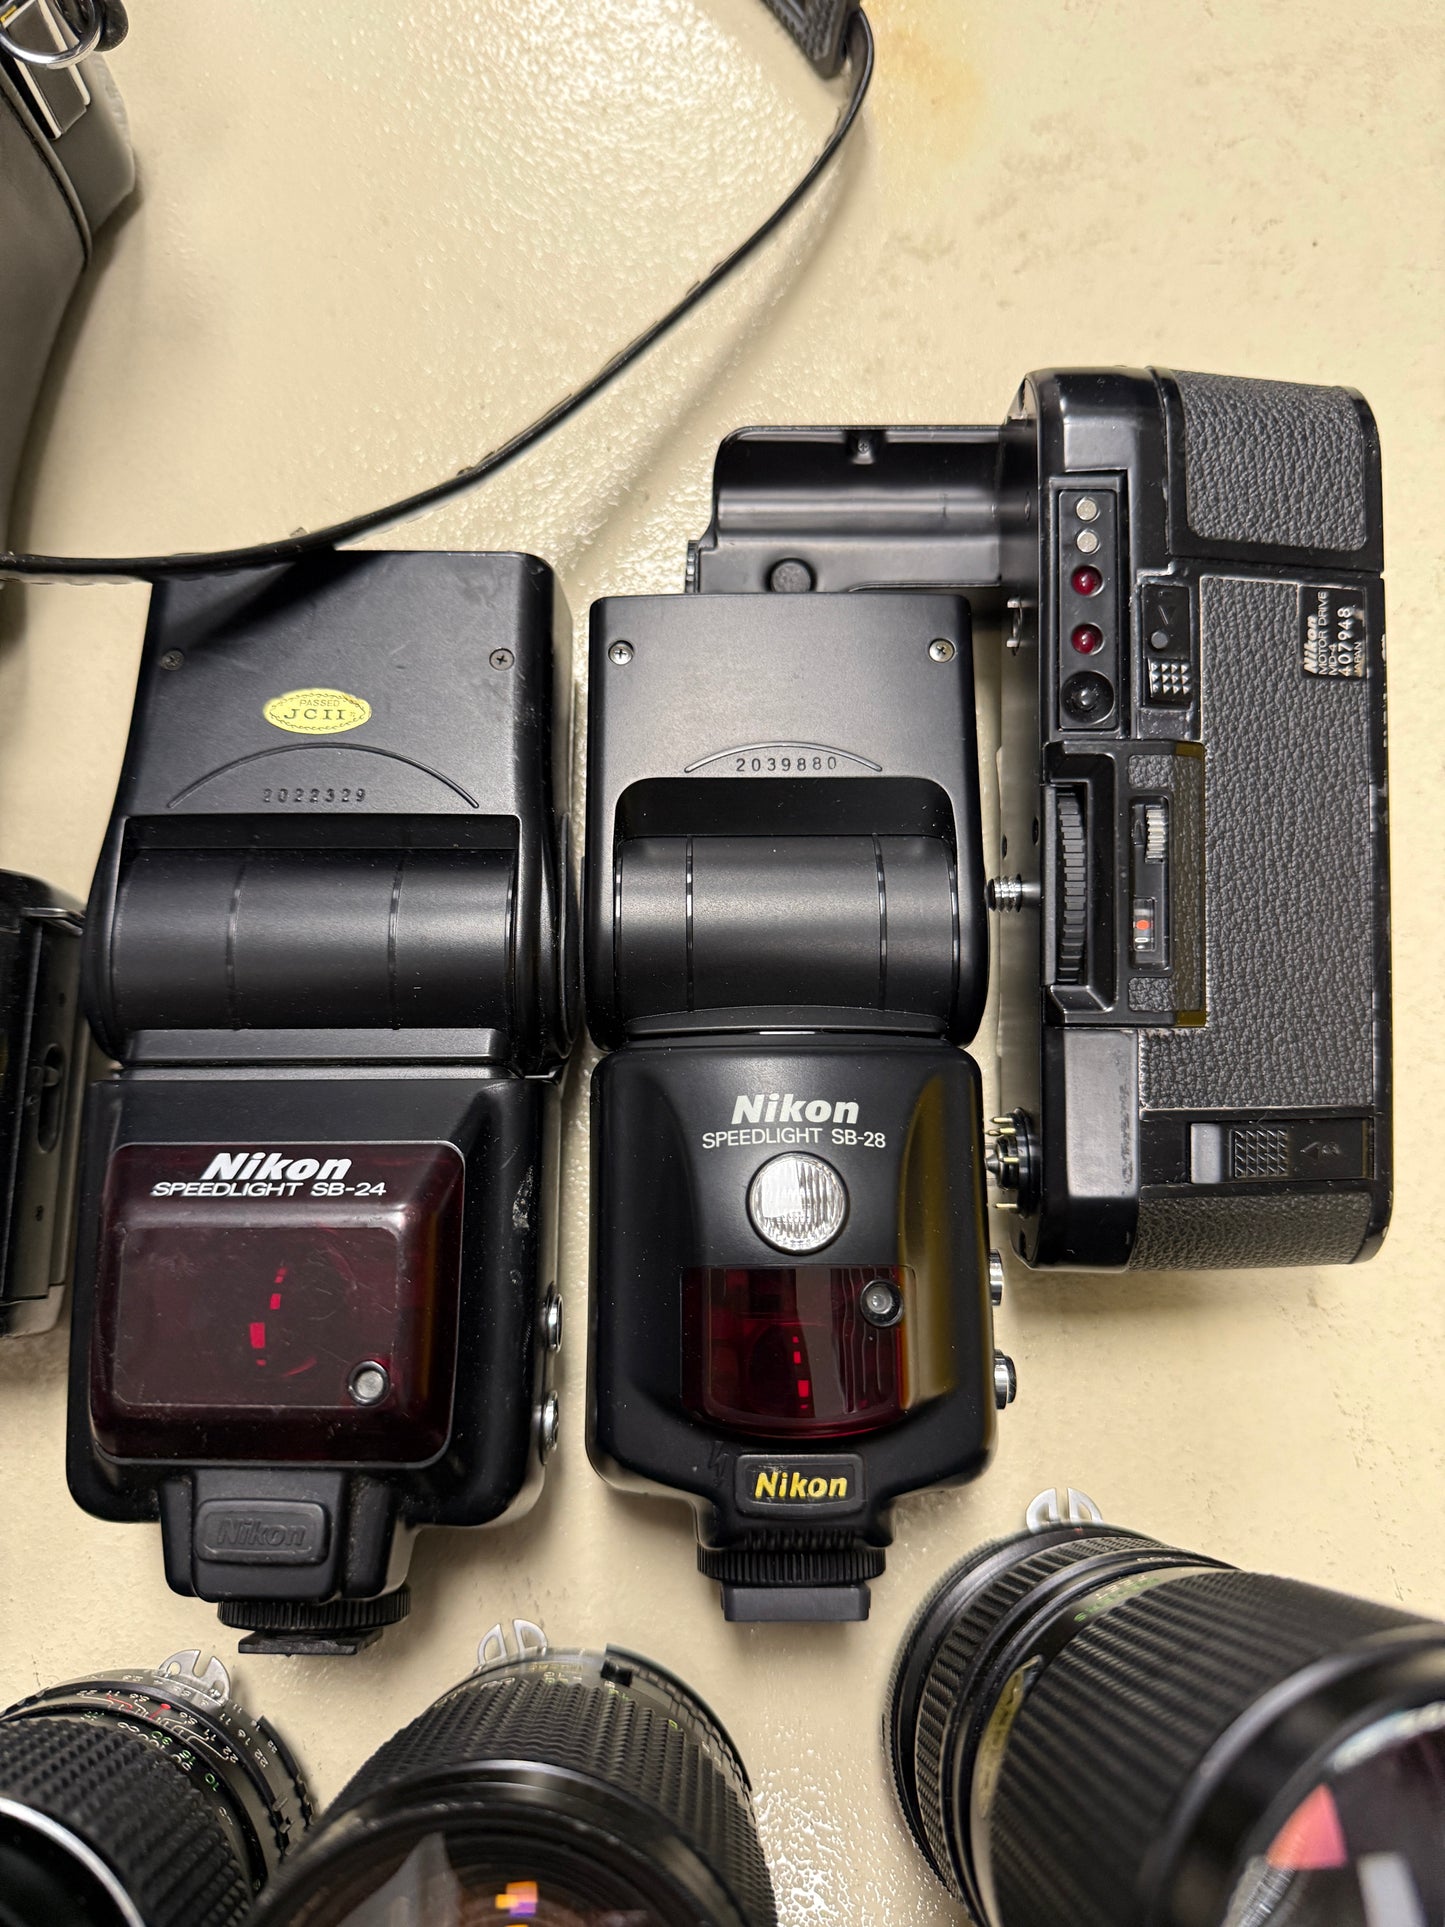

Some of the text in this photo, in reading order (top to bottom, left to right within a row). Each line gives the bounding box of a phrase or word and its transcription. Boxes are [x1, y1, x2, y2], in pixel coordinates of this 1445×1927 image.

[1304, 614, 1317, 673] Nikon
[1318, 591, 1328, 675] MOTOR DRIVE
[1337, 607, 1352, 677] 407948
[1328, 643, 1337, 676] MD-4
[1354, 641, 1362, 674] JAPAN
[284, 708, 347, 721] JCII
[299, 698, 341, 707] PASSED
[735, 756, 837, 773] 2039880
[731, 1093, 860, 1125] Nikon
[702, 1127, 887, 1149] SPEEDLIGHT SB-28
[200, 1152, 353, 1181] Nikon
[151, 1182, 387, 1197] SPEEDLIGHT SB-24
[754, 1471, 848, 1498] Nikon
[216, 1518, 307, 1547] Nikon
[236, 1730, 251, 1746] 16
[222, 1745, 239, 1764] 22
[253, 1748, 270, 1768] 22
